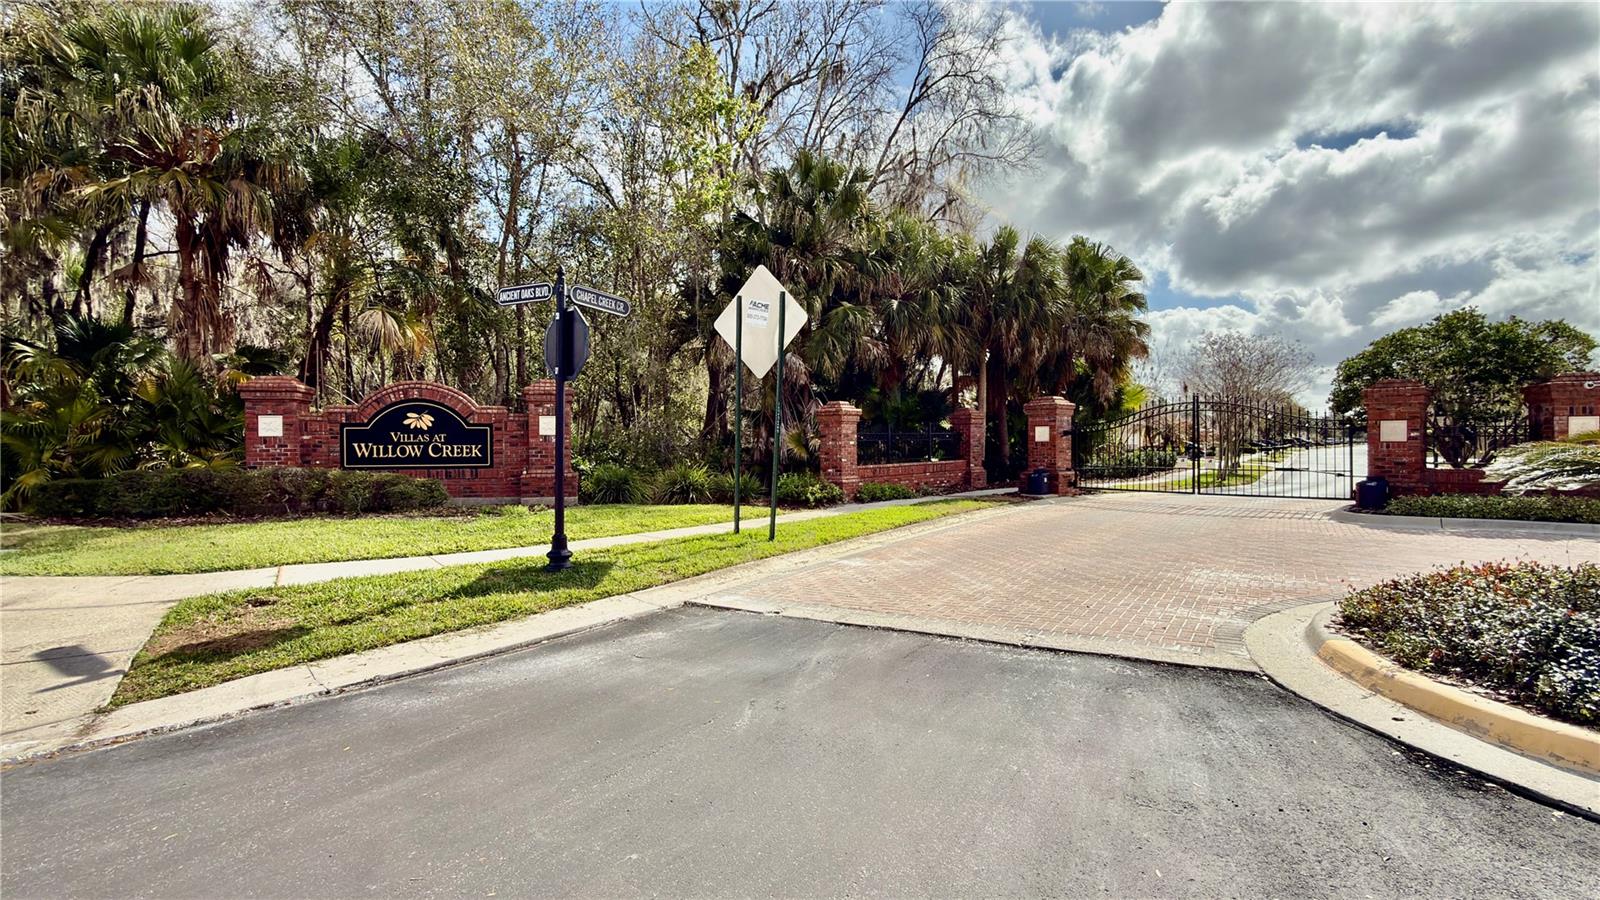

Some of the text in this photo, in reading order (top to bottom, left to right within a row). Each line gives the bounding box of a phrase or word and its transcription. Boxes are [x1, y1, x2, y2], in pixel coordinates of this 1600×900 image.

[499, 290, 520, 301] ANCIENT
[521, 288, 535, 299] OAKS
[576, 289, 597, 304] CHAPEL
[598, 295, 616, 310] CREEK
[390, 432, 447, 443] VILLAS AT
[352, 442, 482, 458] WILLOW CREEK
